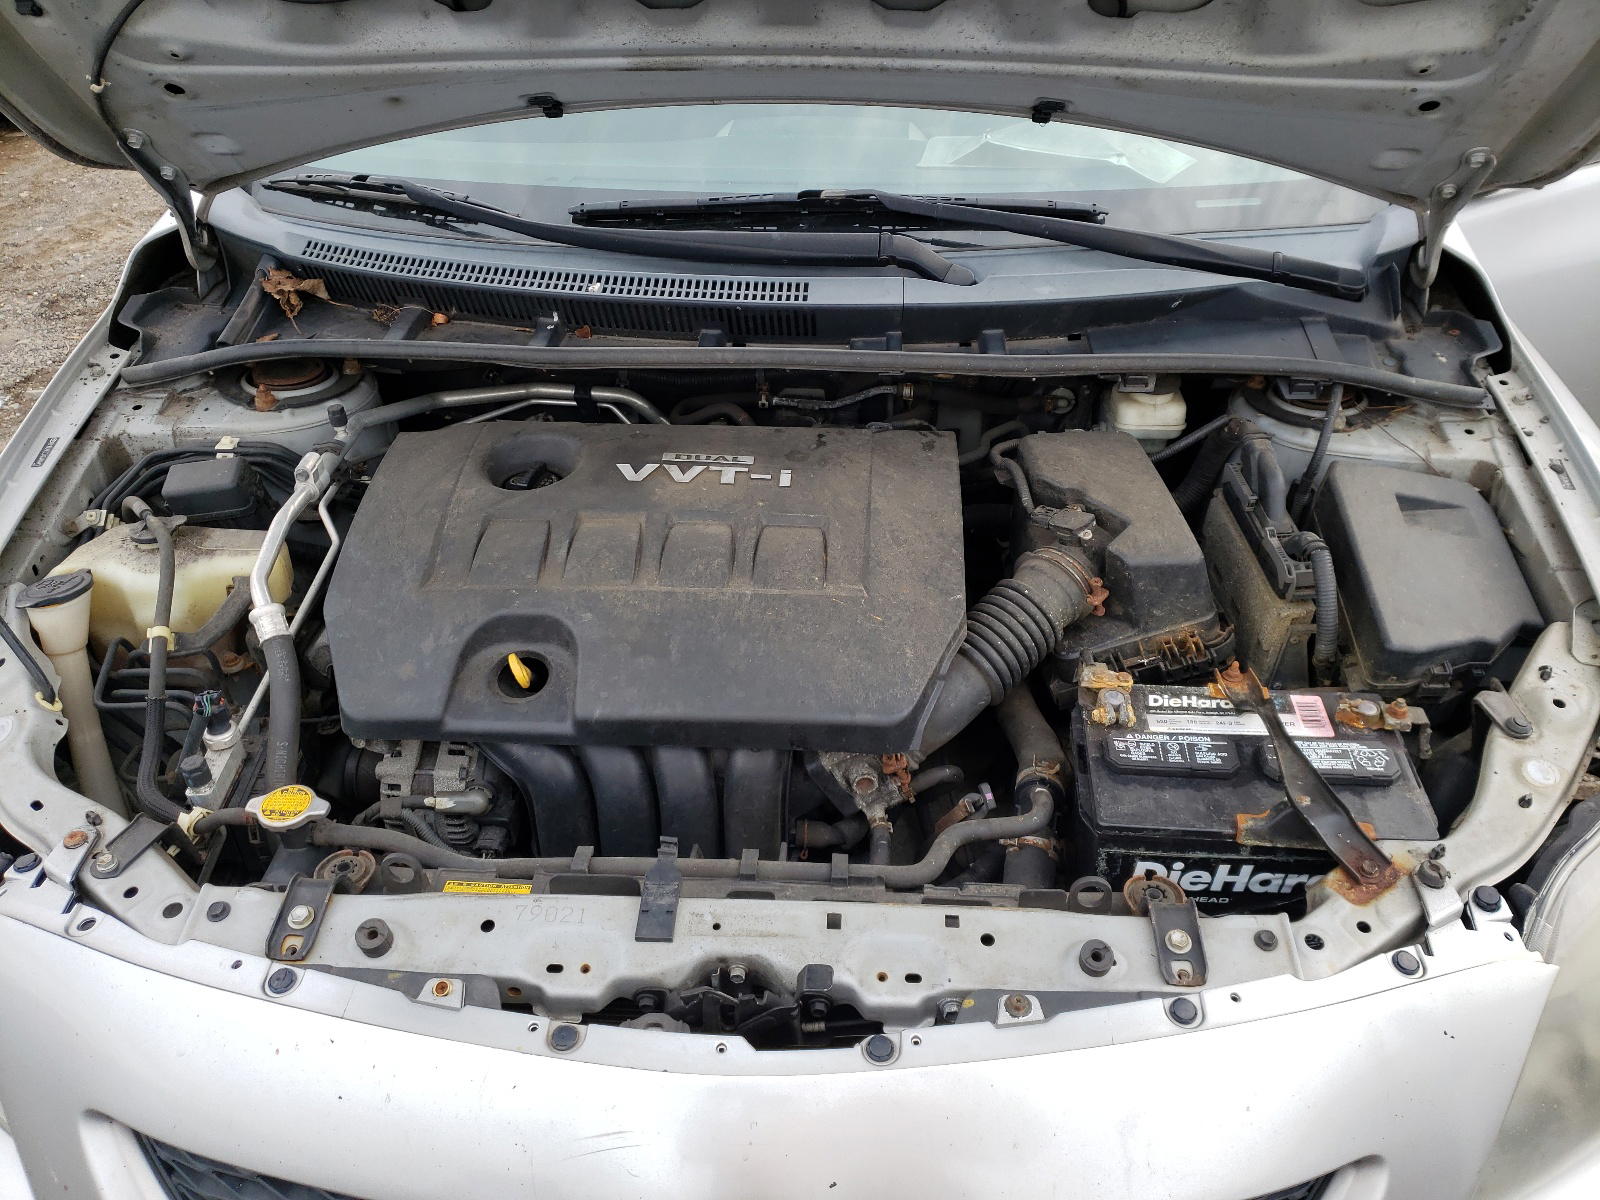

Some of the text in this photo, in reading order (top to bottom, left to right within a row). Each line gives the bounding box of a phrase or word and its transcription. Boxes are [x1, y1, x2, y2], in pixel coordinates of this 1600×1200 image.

[672, 453, 750, 464] DUAL
[615, 463, 793, 487] VVT-i
[1133, 861, 1328, 893] DieHar
